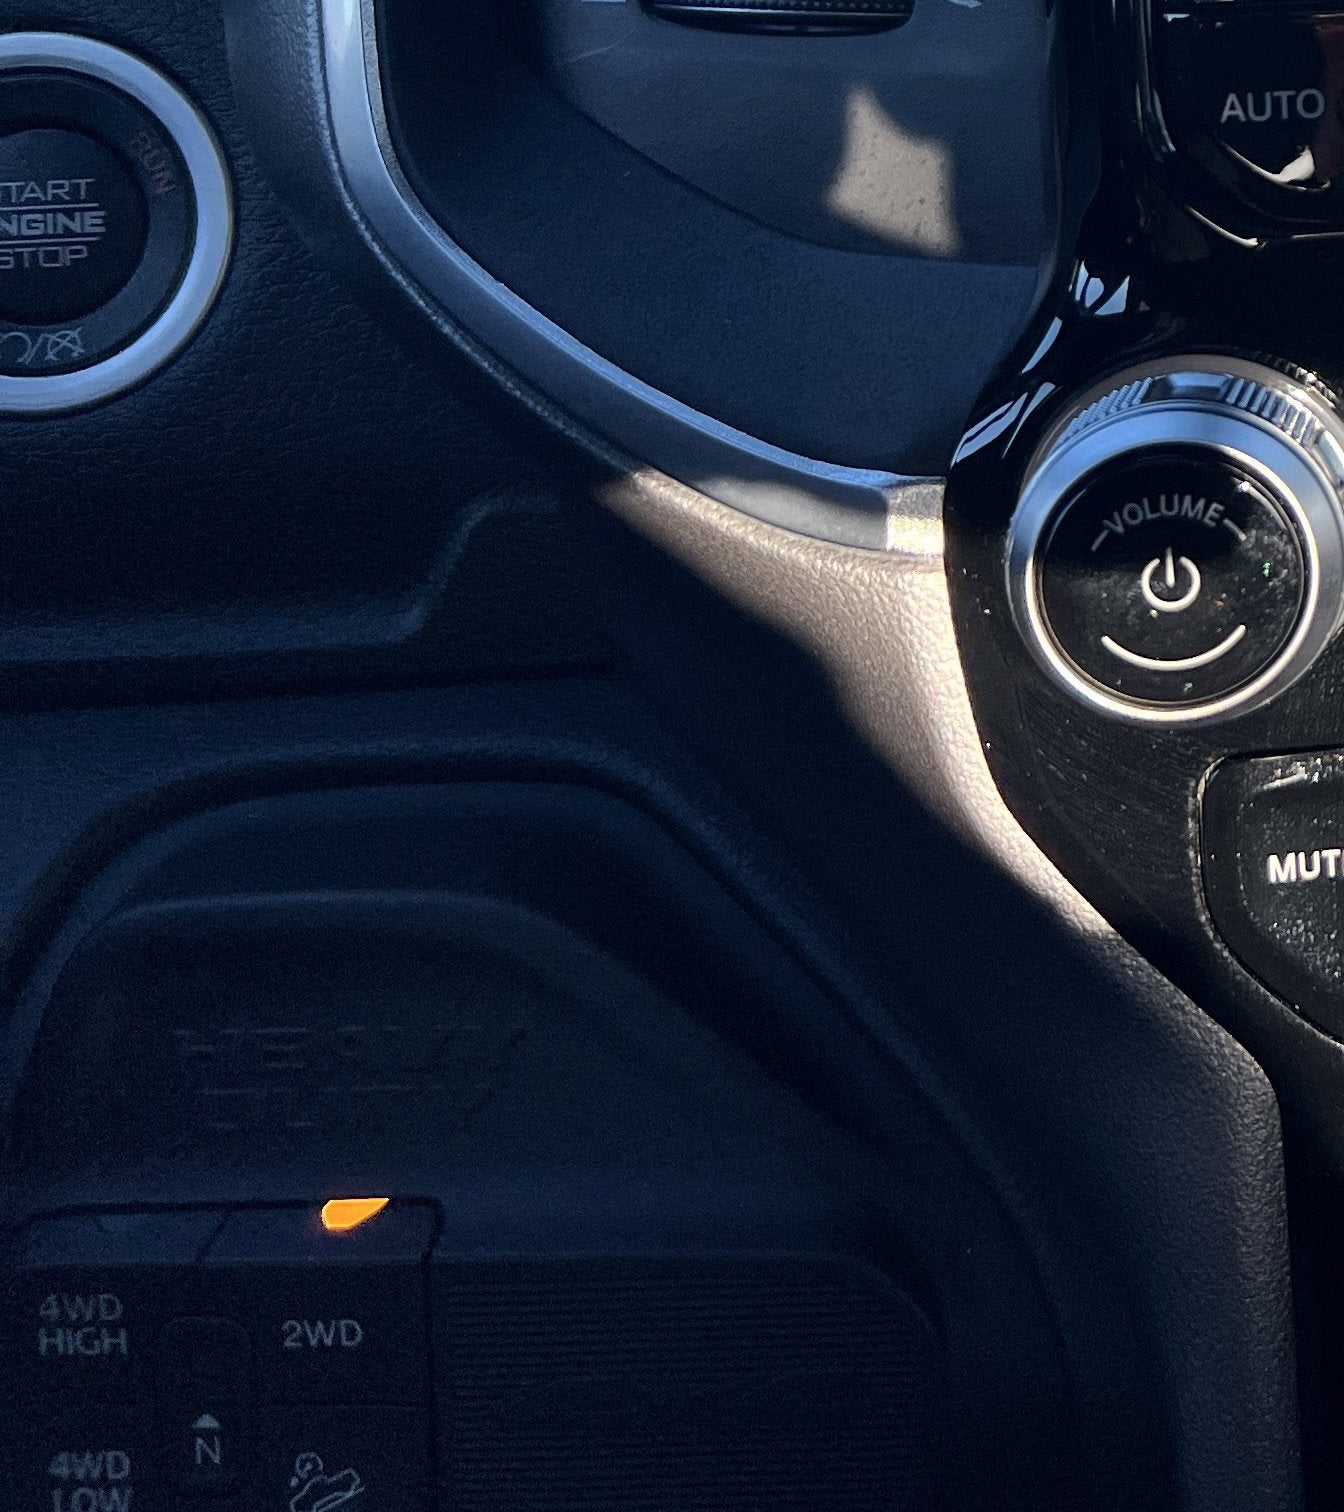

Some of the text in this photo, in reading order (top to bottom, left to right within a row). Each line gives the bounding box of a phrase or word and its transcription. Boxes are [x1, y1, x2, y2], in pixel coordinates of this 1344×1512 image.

[1221, 89, 1324, 122] AUTO
[131, 131, 177, 196] RUN
[0, 178, 96, 204] TART
[1105, 494, 1226, 535] VOLUME
[40, 1294, 122, 1320] 4WD
[40, 1327, 126, 1355] HIGH
[283, 1320, 362, 1347] 2WD
[50, 1451, 130, 1479] 4WD
[196, 1438, 220, 1464] N
